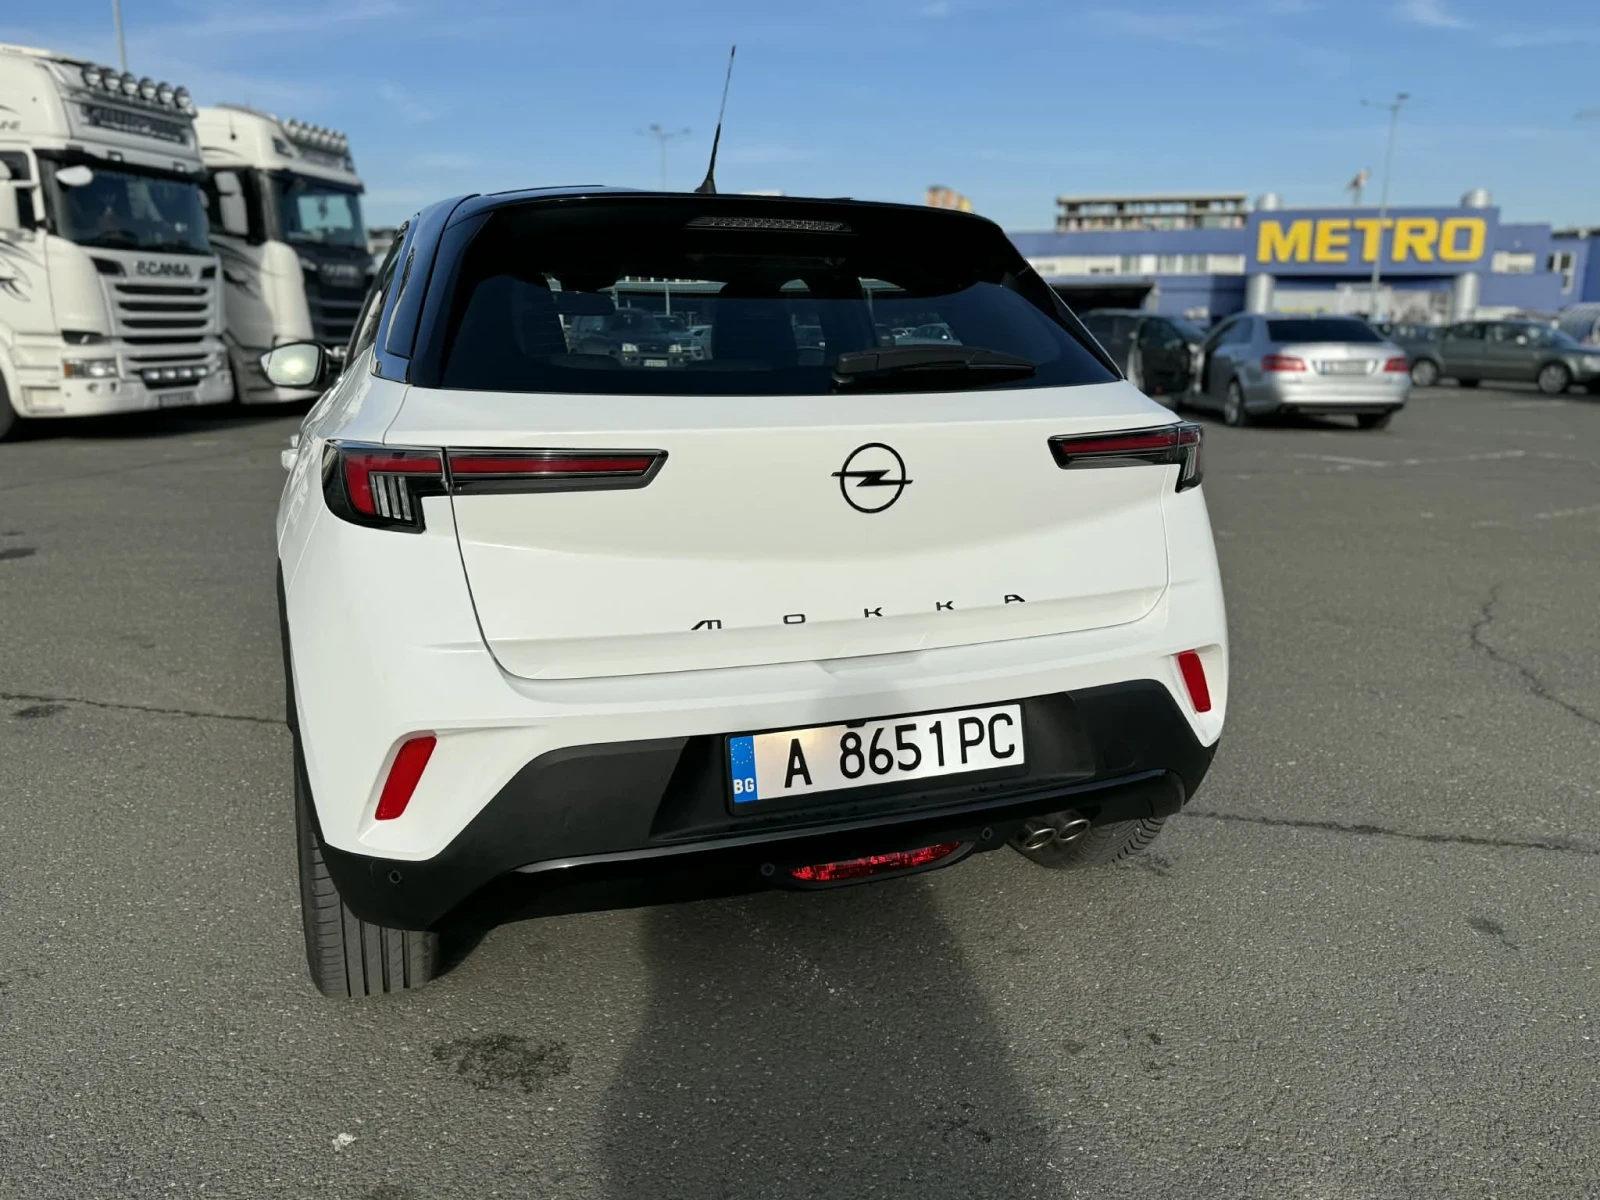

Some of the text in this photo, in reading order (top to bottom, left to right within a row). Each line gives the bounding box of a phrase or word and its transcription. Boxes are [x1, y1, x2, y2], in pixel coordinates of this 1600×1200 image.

[1256, 217, 1487, 263] METRO
[691, 593, 1026, 631] MOKKA
[784, 712, 1016, 788] A 8651PC
[733, 778, 755, 795] BG
